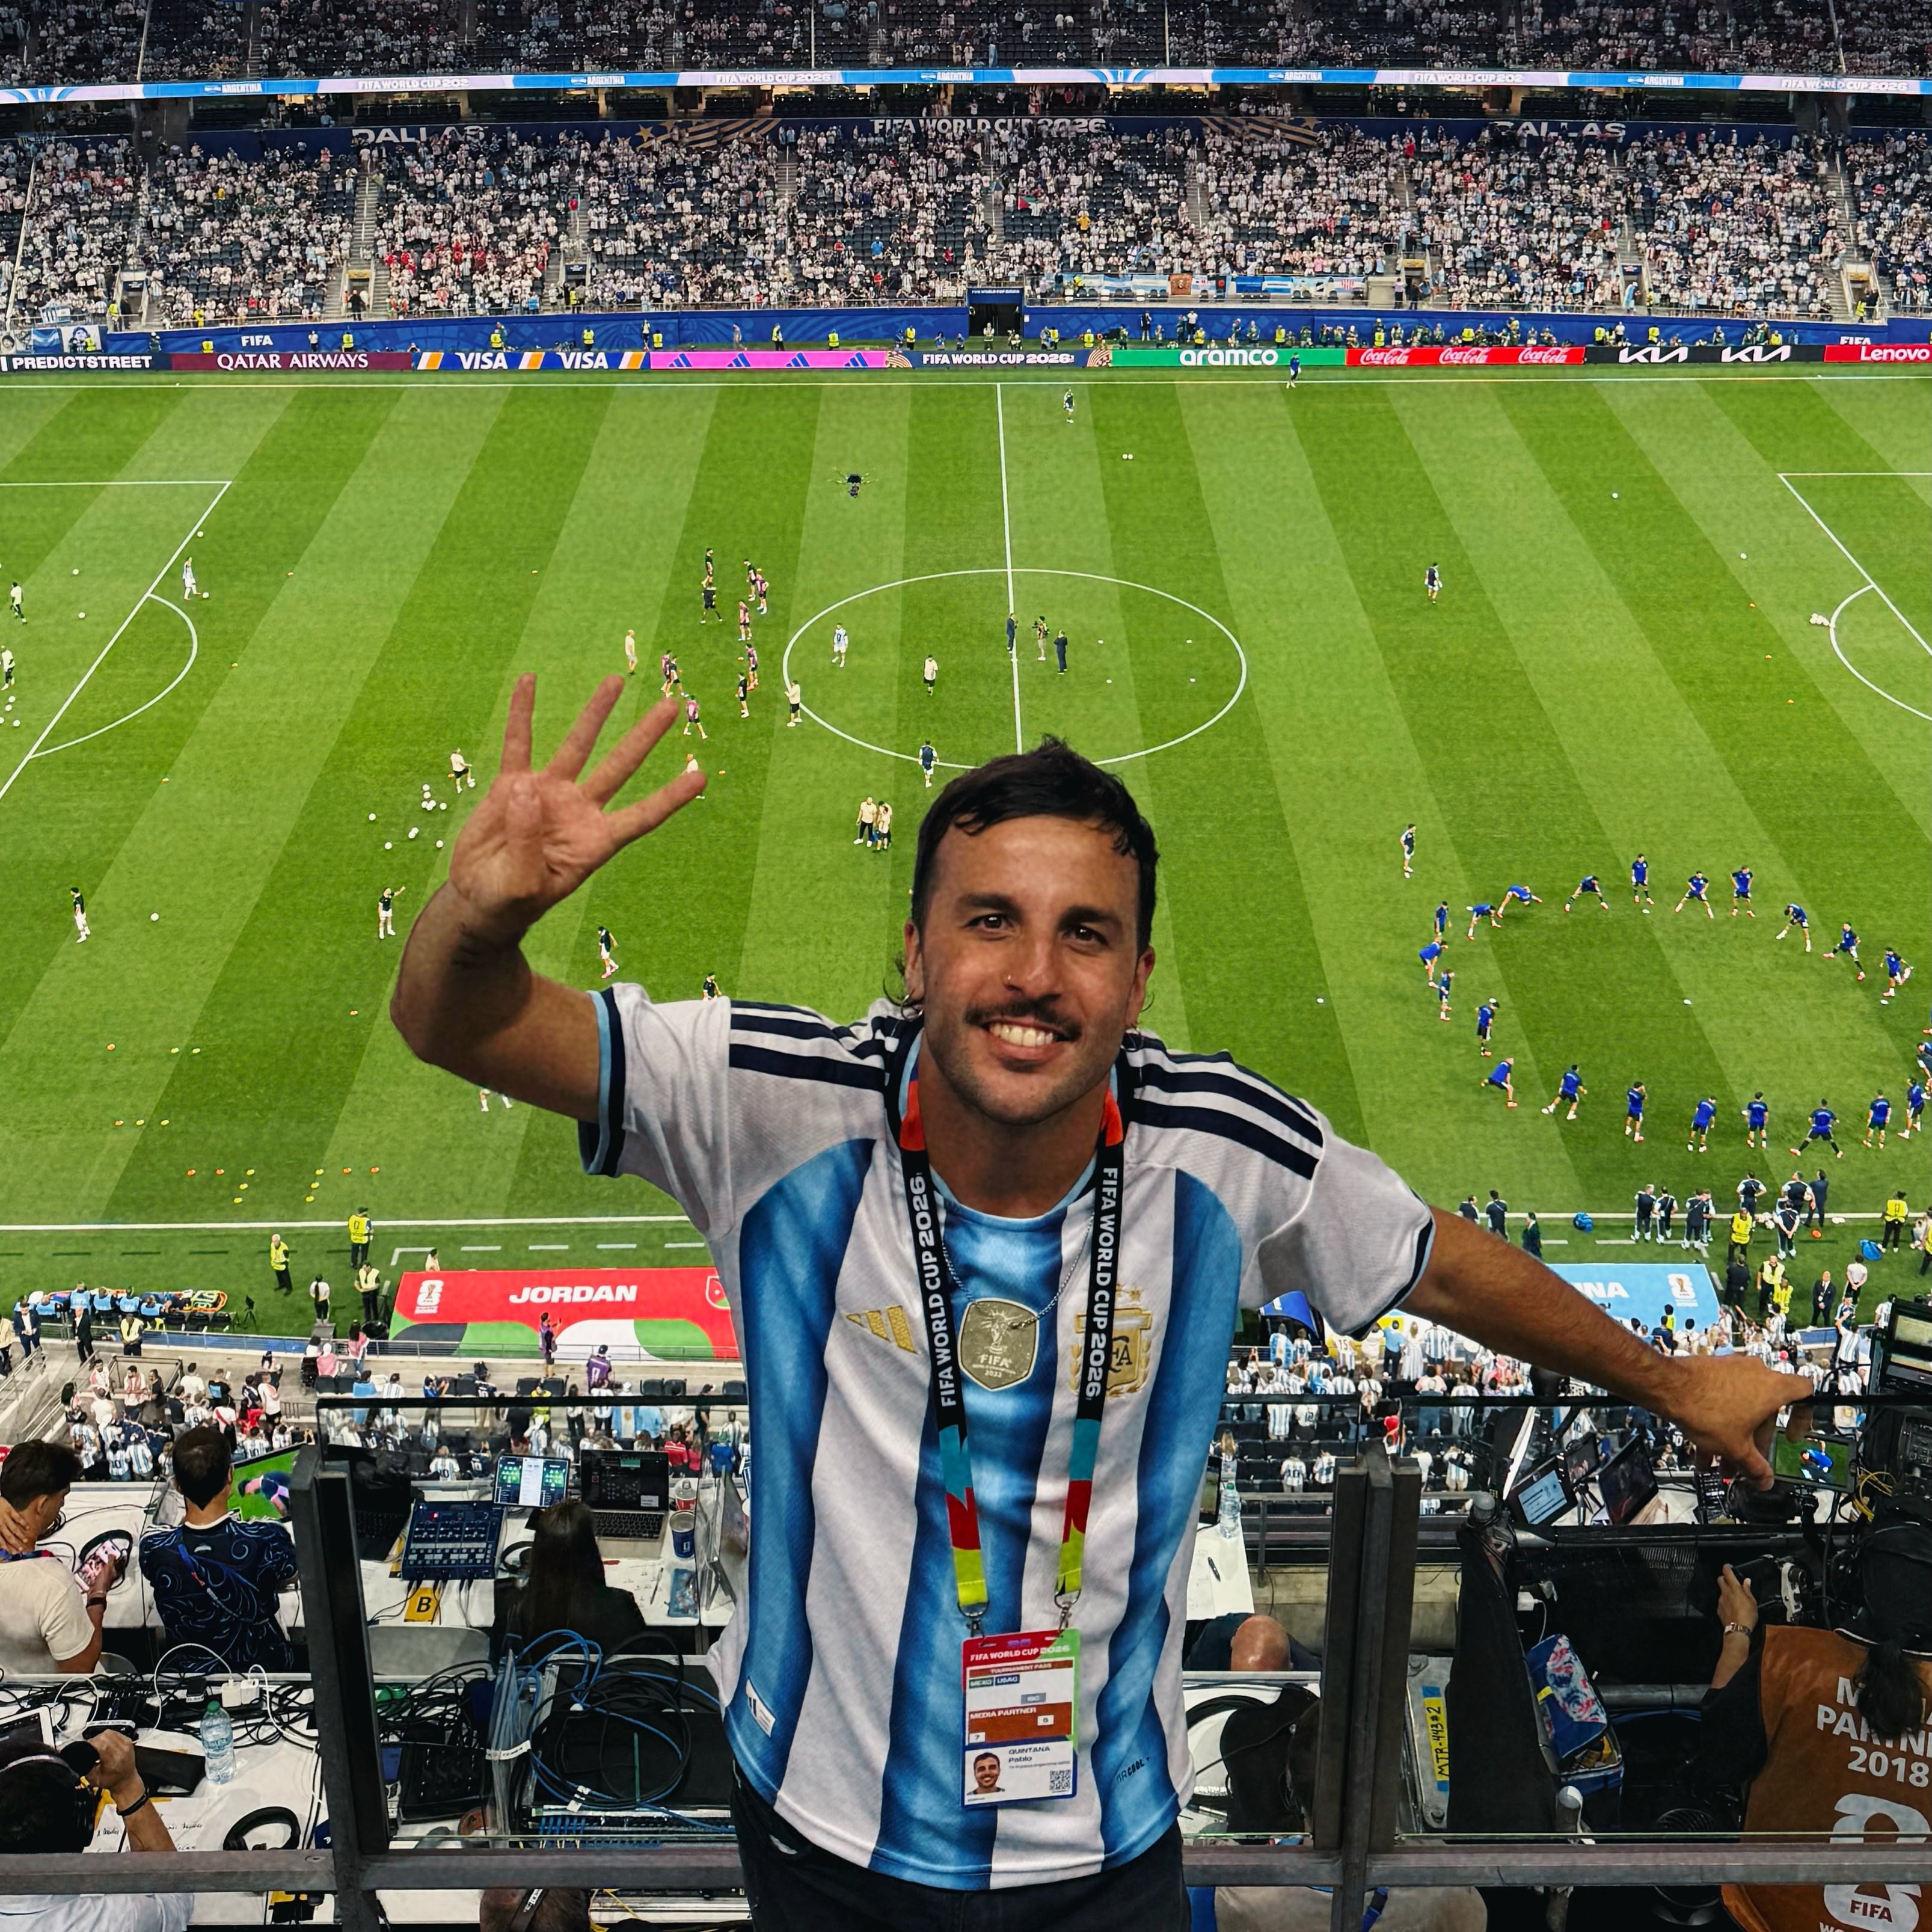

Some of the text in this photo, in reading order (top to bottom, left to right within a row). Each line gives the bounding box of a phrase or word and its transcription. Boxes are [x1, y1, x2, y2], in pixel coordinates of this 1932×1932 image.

[358, 81, 381, 90] FIFA
[382, 80, 420, 88] WORLD
[420, 79, 441, 88] CUP
[716, 74, 739, 83] FIFA
[739, 74, 774, 82] WORLD
[1414, 73, 1435, 82] FIFA
[1438, 73, 1474, 82] WORLD
[1475, 74, 1494, 82] CUP
[1781, 79, 1802, 88] FIFA
[1846, 81, 1866, 90] CUP
[1867, 81, 1908, 91] 2026
[874, 119, 916, 133] FIFA
[919, 119, 991, 133] WORLD
[241, 335, 273, 346] FIFA
[1840, 336, 1871, 345] FIFA
[922, 354, 950, 364] FIFA
[951, 354, 998, 364] WORLD
[999, 354, 1025, 364] CUP
[1179, 349, 1278, 366] aramco
[1619, 347, 1688, 363] KIA
[1721, 345, 1791, 363] KIA
[1860, 345, 1930, 361] Lenovo
[12, 355, 152, 370] PREDICTSTREET
[217, 352, 369, 370] QATAR AIRWAYS
[455, 352, 509, 370] VISA
[556, 352, 609, 370] VISA
[1085, 1167, 1118, 1397] FIFA WORLD CUP 2026
[509, 1285, 637, 1304] JORDAN
[910, 1175, 957, 1407] FIFA WORLD CUP 2026
[980, 1354, 1010, 1368] FIFA
[1672, 1435, 1684, 1447] 10
[416, 1596, 432, 1613] B
[970, 1652, 990, 1662] FIFA
[990, 1649, 1021, 1659] WORLD
[969, 1707, 1037, 1720] MEDIA PARTNER
[1008, 1746, 1050, 1755] QUINTANA
[1847, 1746, 1930, 1787] 2018
[1850, 1899, 1893, 1923] FIFA
